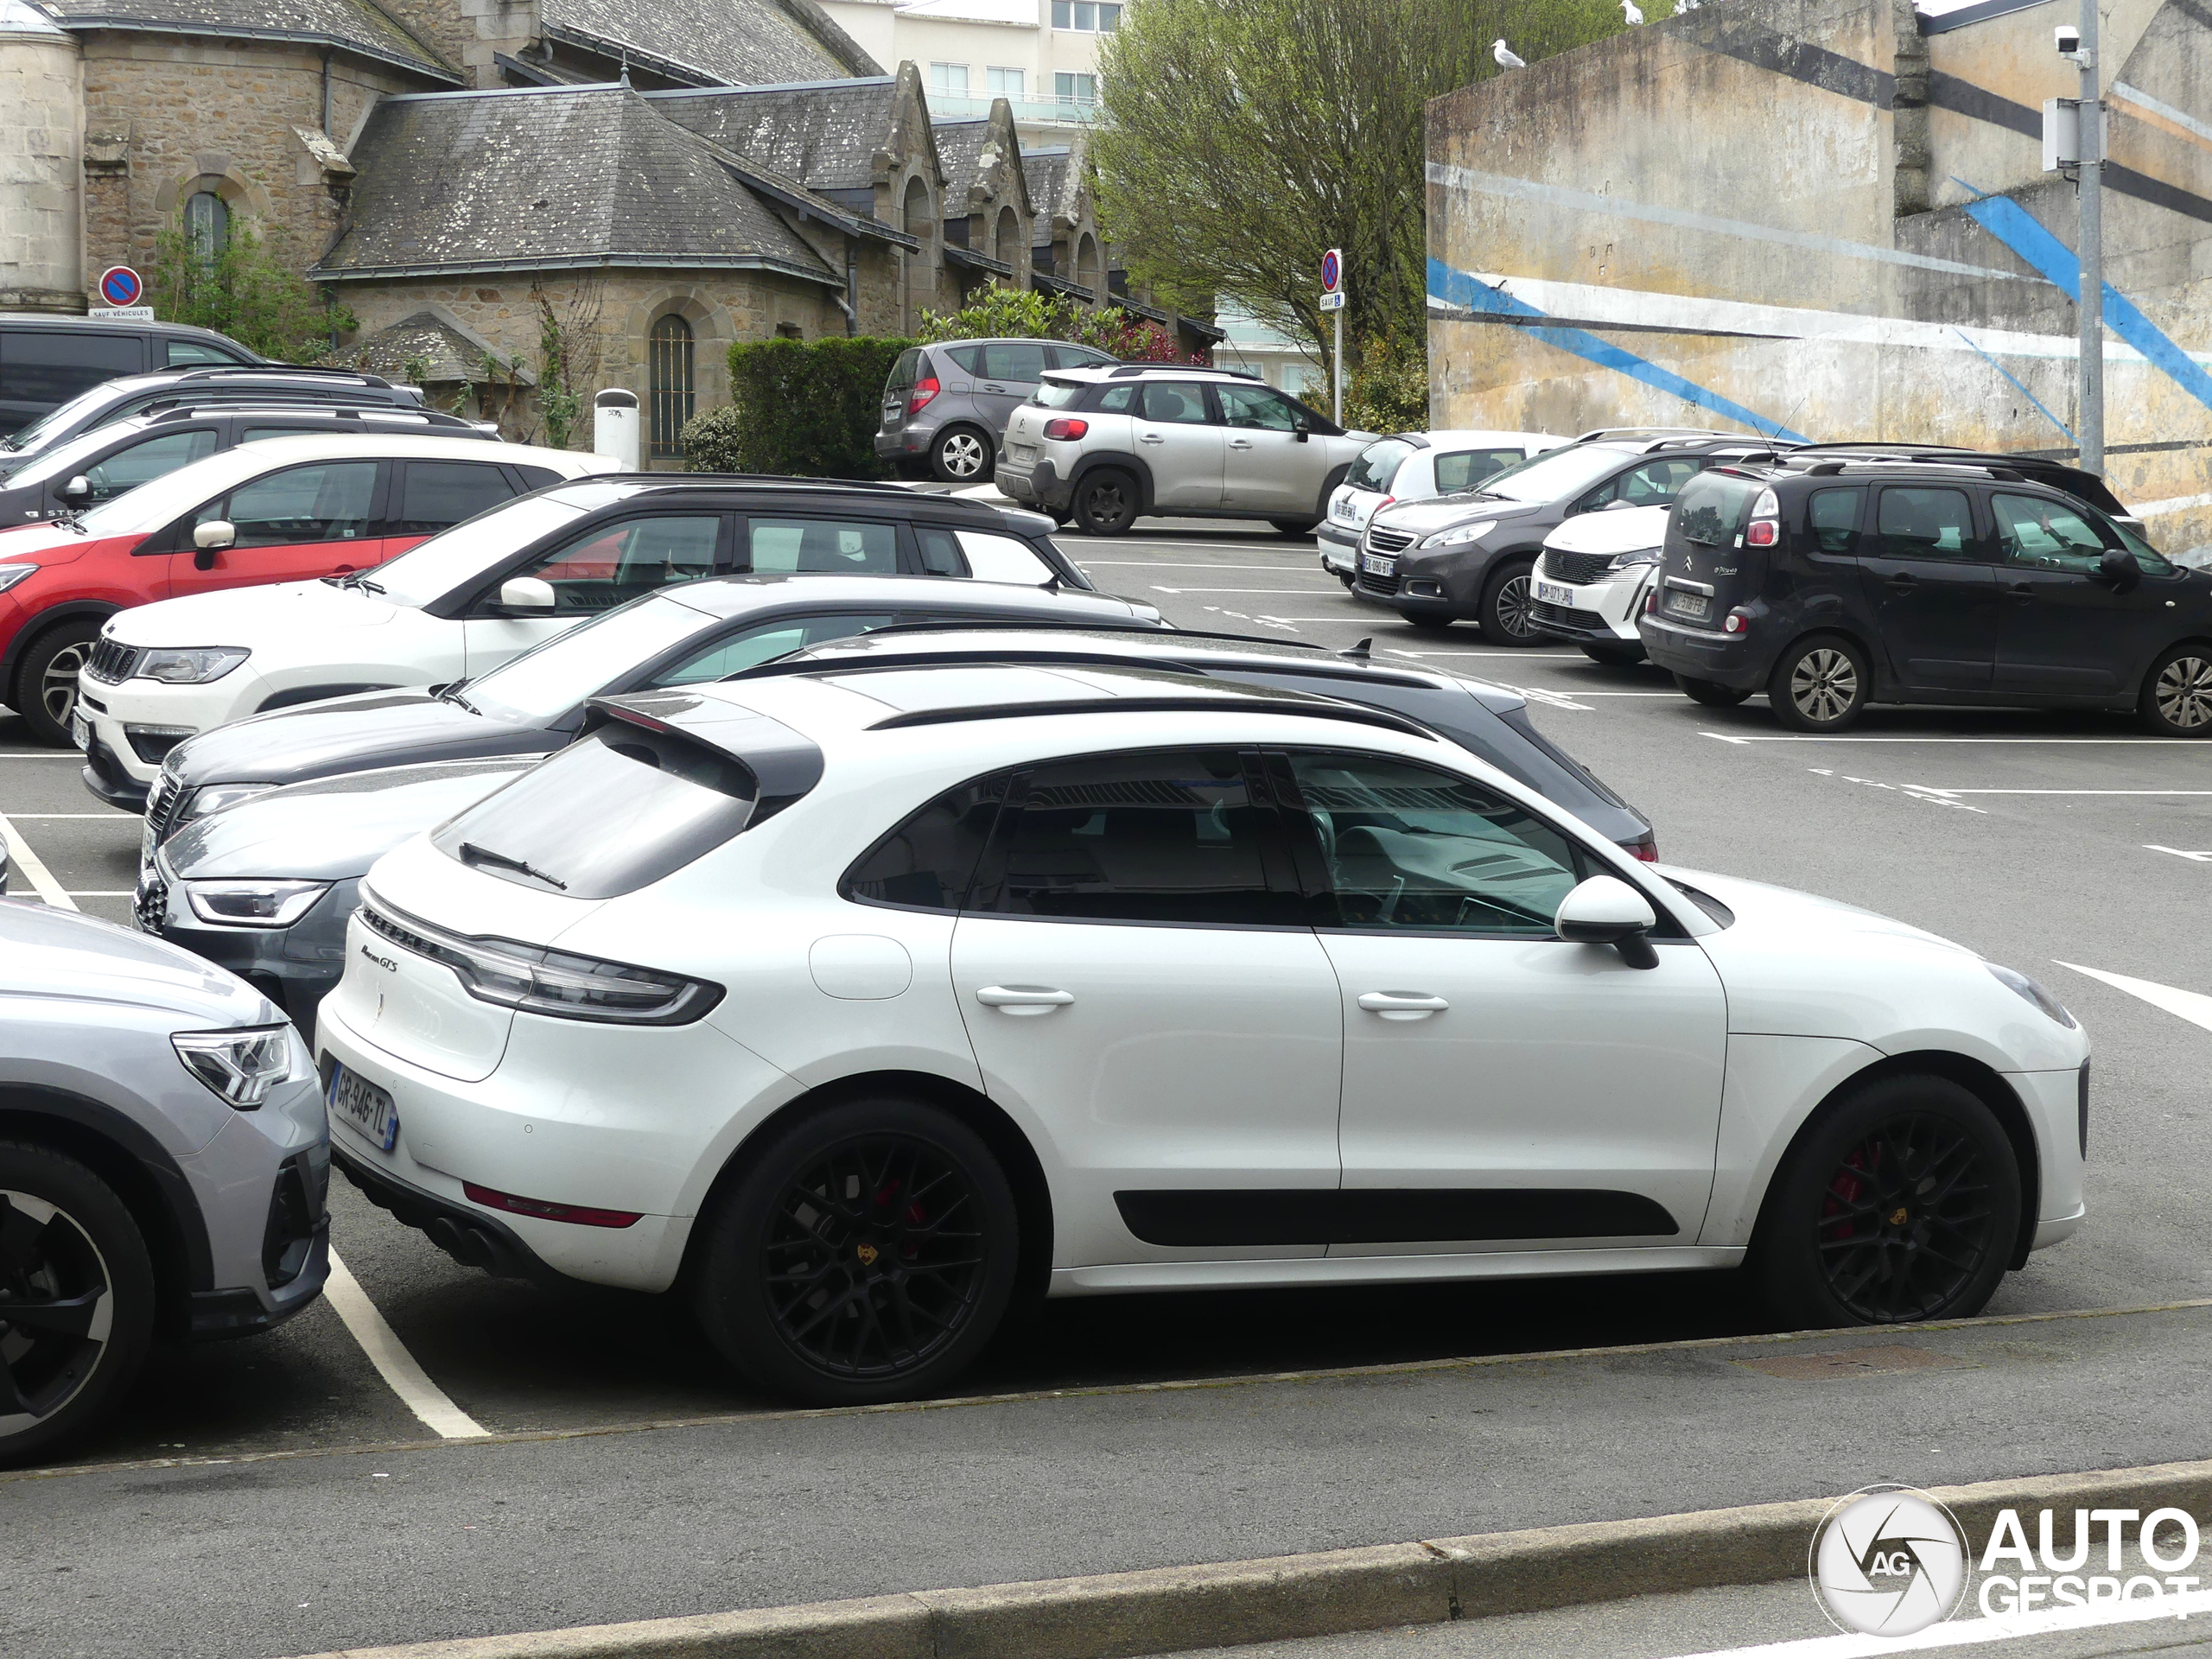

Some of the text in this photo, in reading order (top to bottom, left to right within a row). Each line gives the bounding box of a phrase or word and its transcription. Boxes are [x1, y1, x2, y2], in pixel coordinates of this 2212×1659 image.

[1321, 298, 1334, 307] SAUF
[1366, 556, 1390, 575] EK-090-BT
[1807, 768, 1988, 814] PAYANT
[380, 957, 397, 972] GTS
[338, 1071, 385, 1136] GR-946-TL
